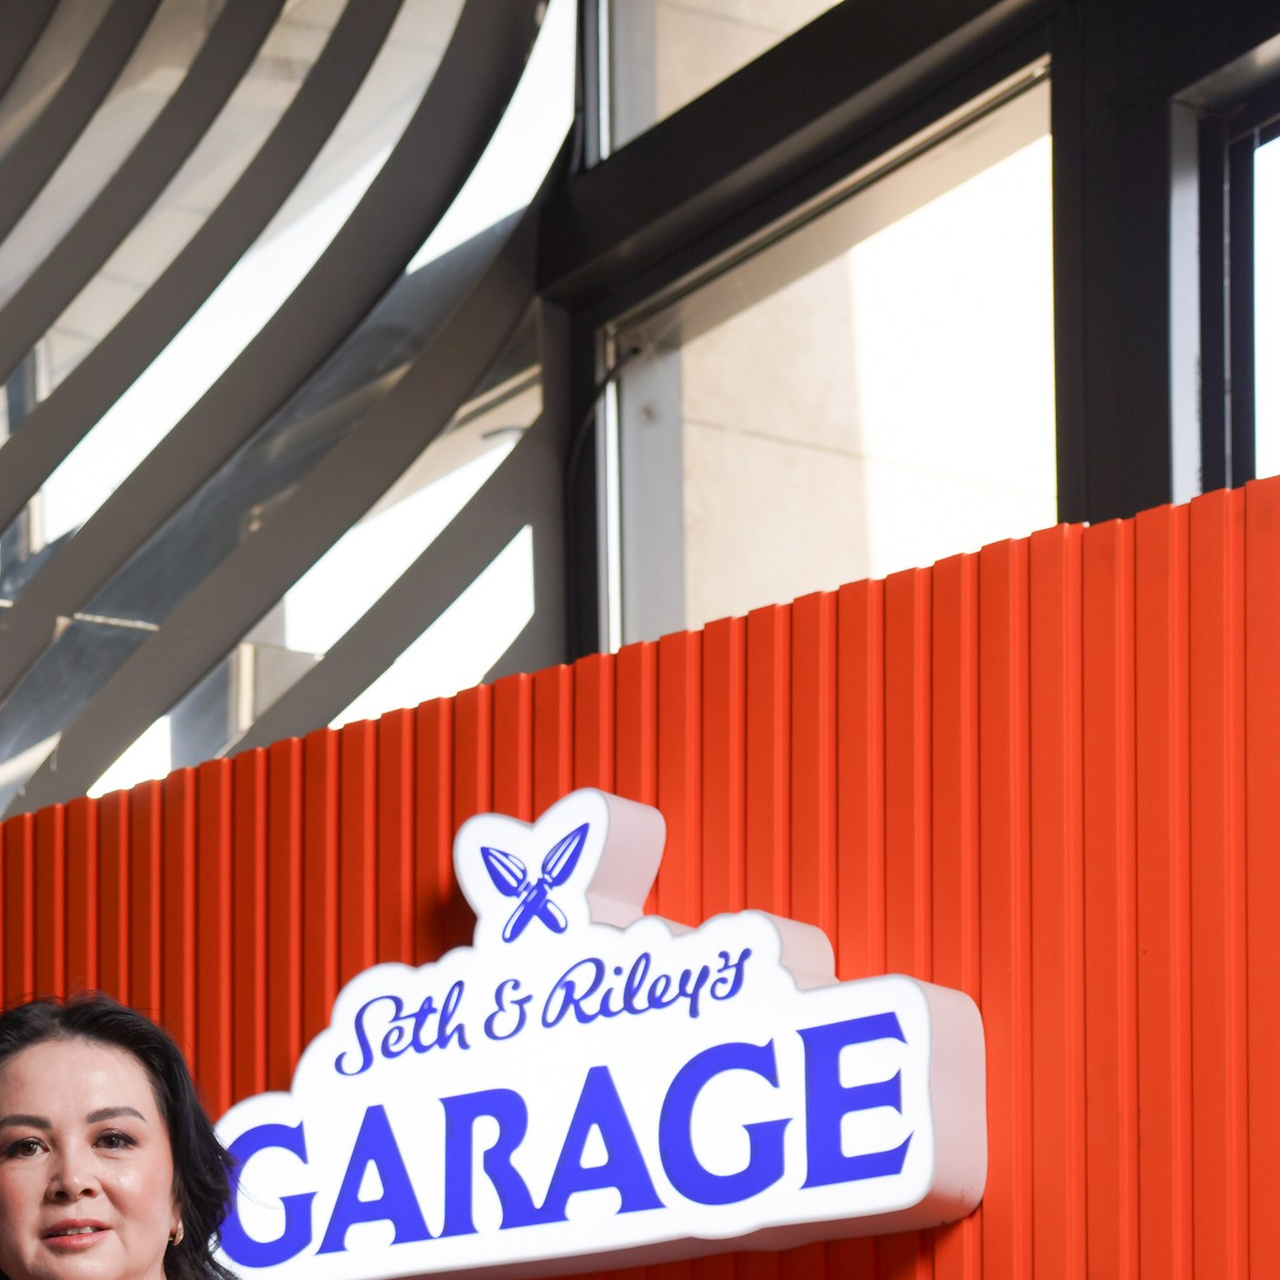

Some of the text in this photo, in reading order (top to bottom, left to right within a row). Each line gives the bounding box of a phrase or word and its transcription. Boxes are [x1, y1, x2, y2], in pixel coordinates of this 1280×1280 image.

[334, 947, 753, 1077] Seth & Riley's
[217, 1010, 914, 1269] GARAGE
